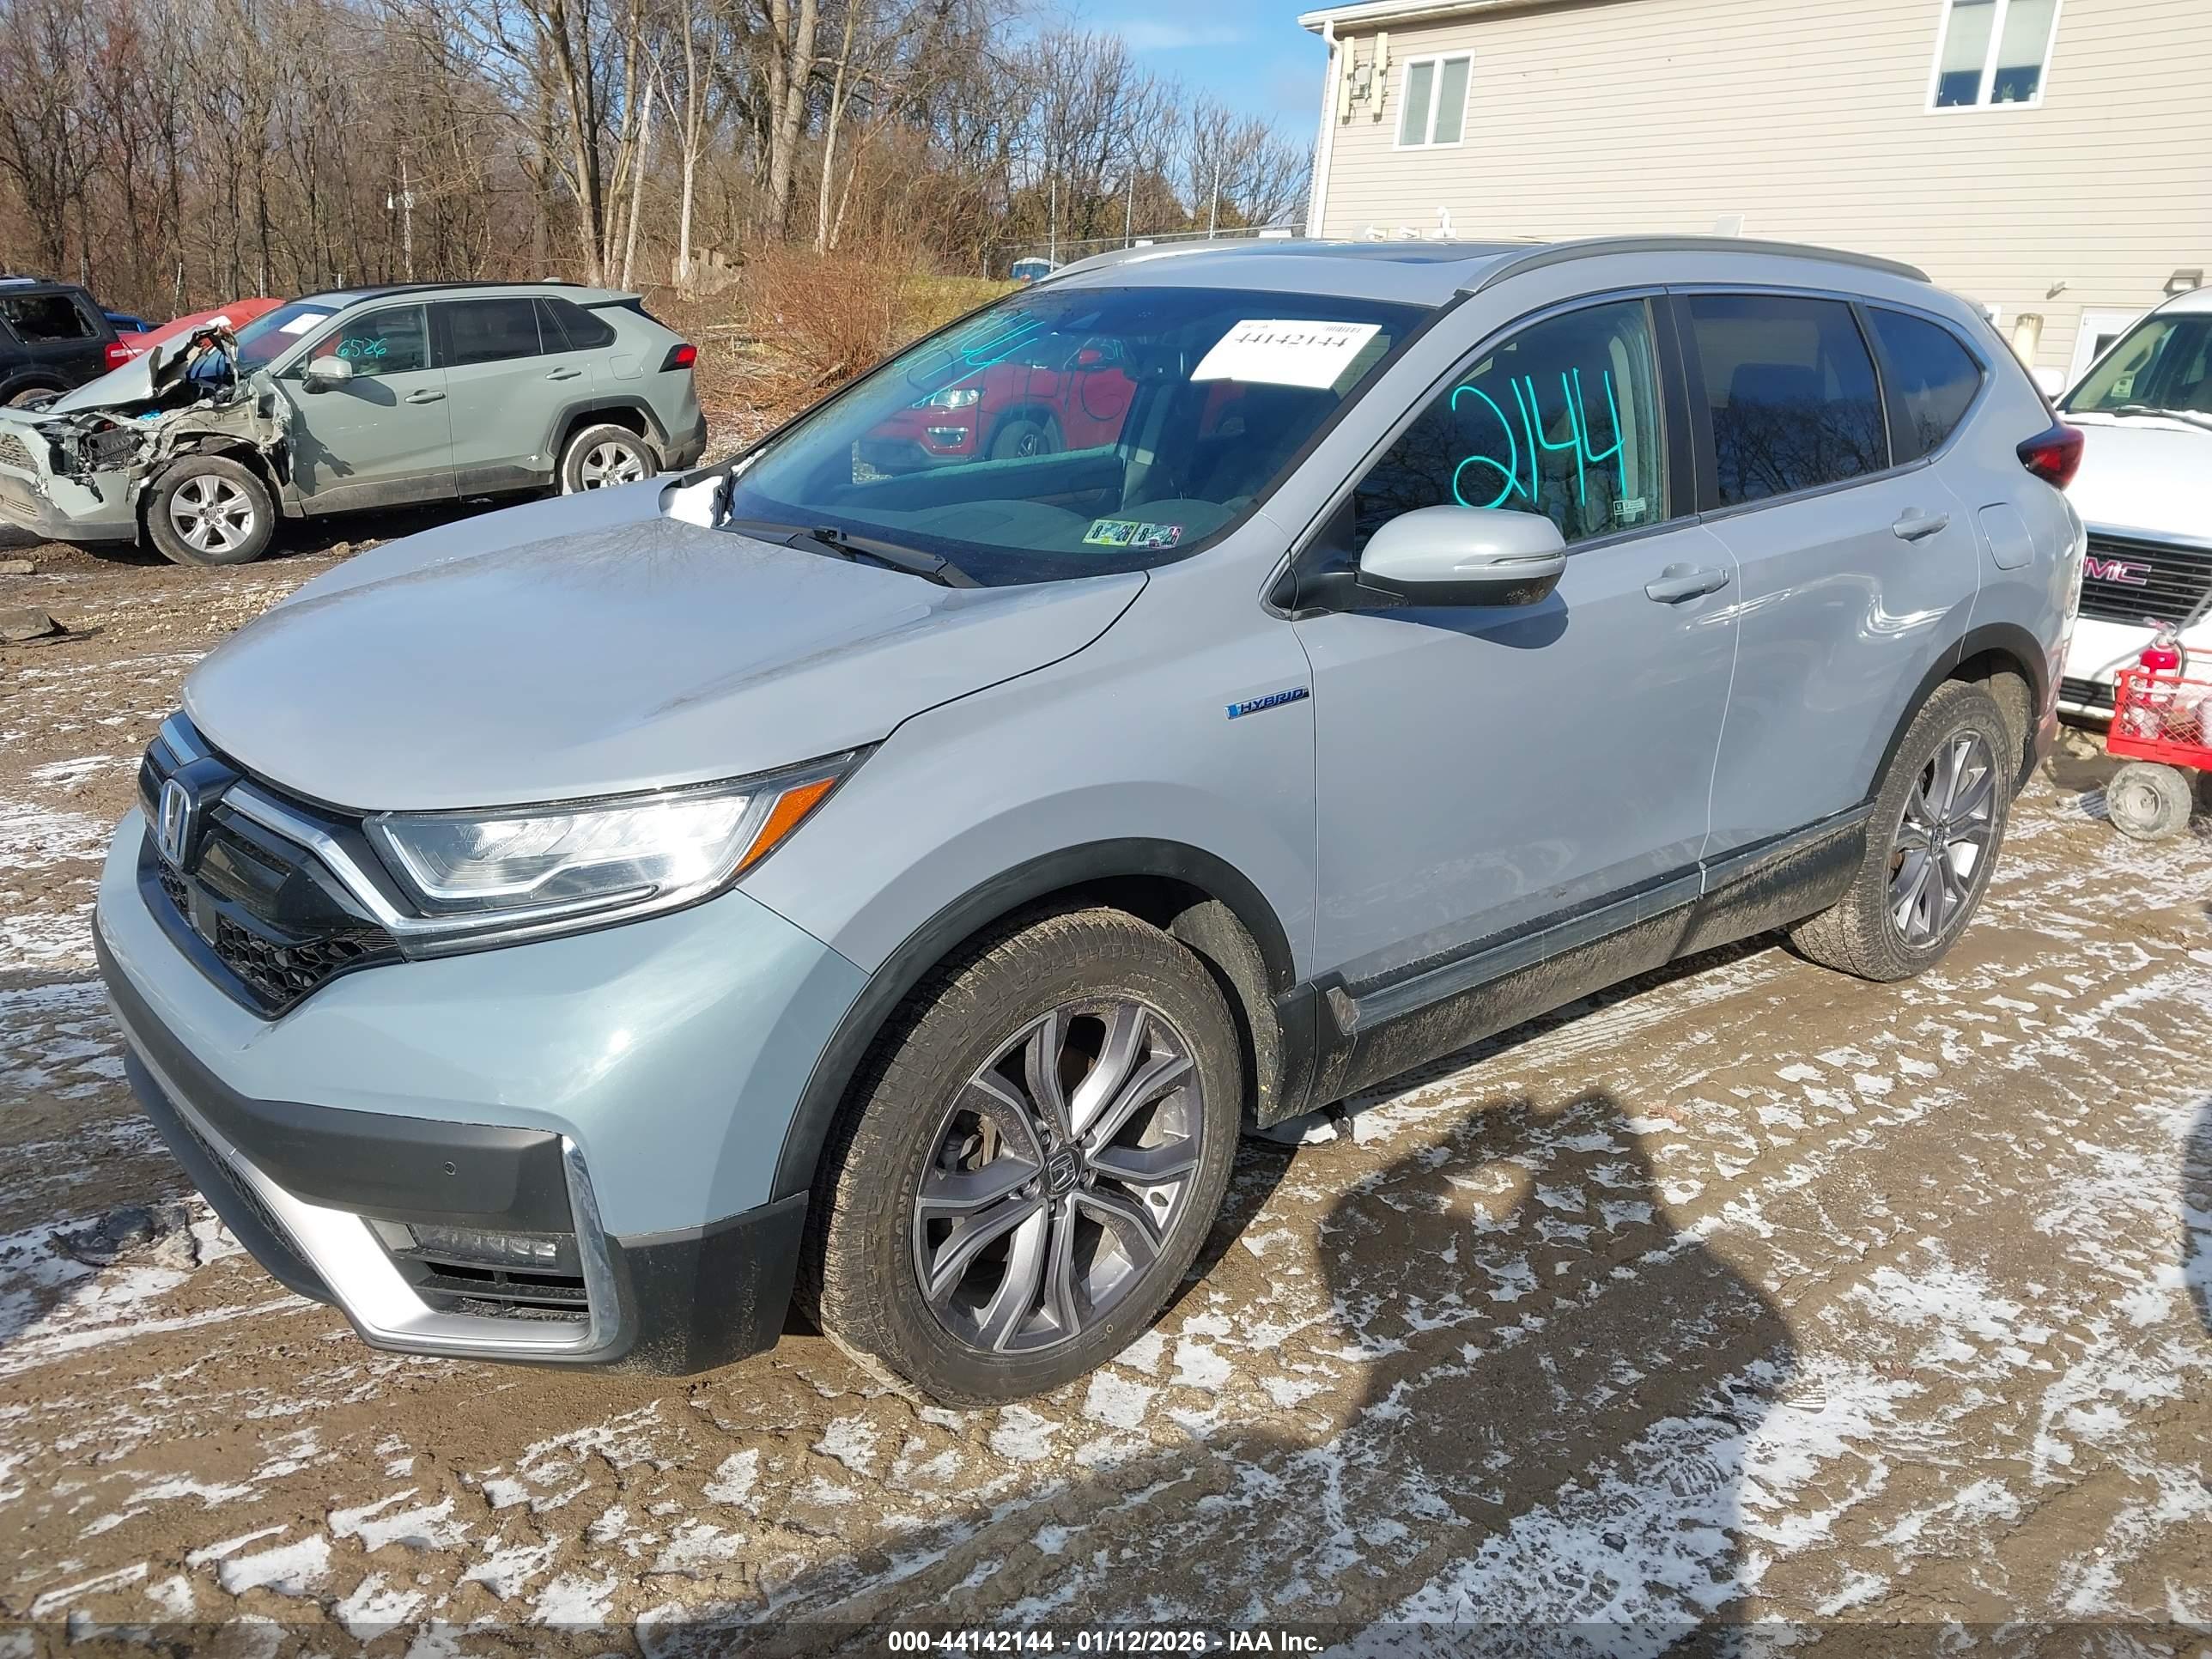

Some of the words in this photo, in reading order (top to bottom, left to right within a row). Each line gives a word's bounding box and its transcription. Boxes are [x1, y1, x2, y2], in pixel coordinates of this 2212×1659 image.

[335, 337, 387, 358] 6526
[1235, 332, 1349, 347] 44142144
[1451, 367, 1627, 508] 2144
[2084, 556, 2152, 586] MC
[1240, 688, 1304, 714] HYBRID
